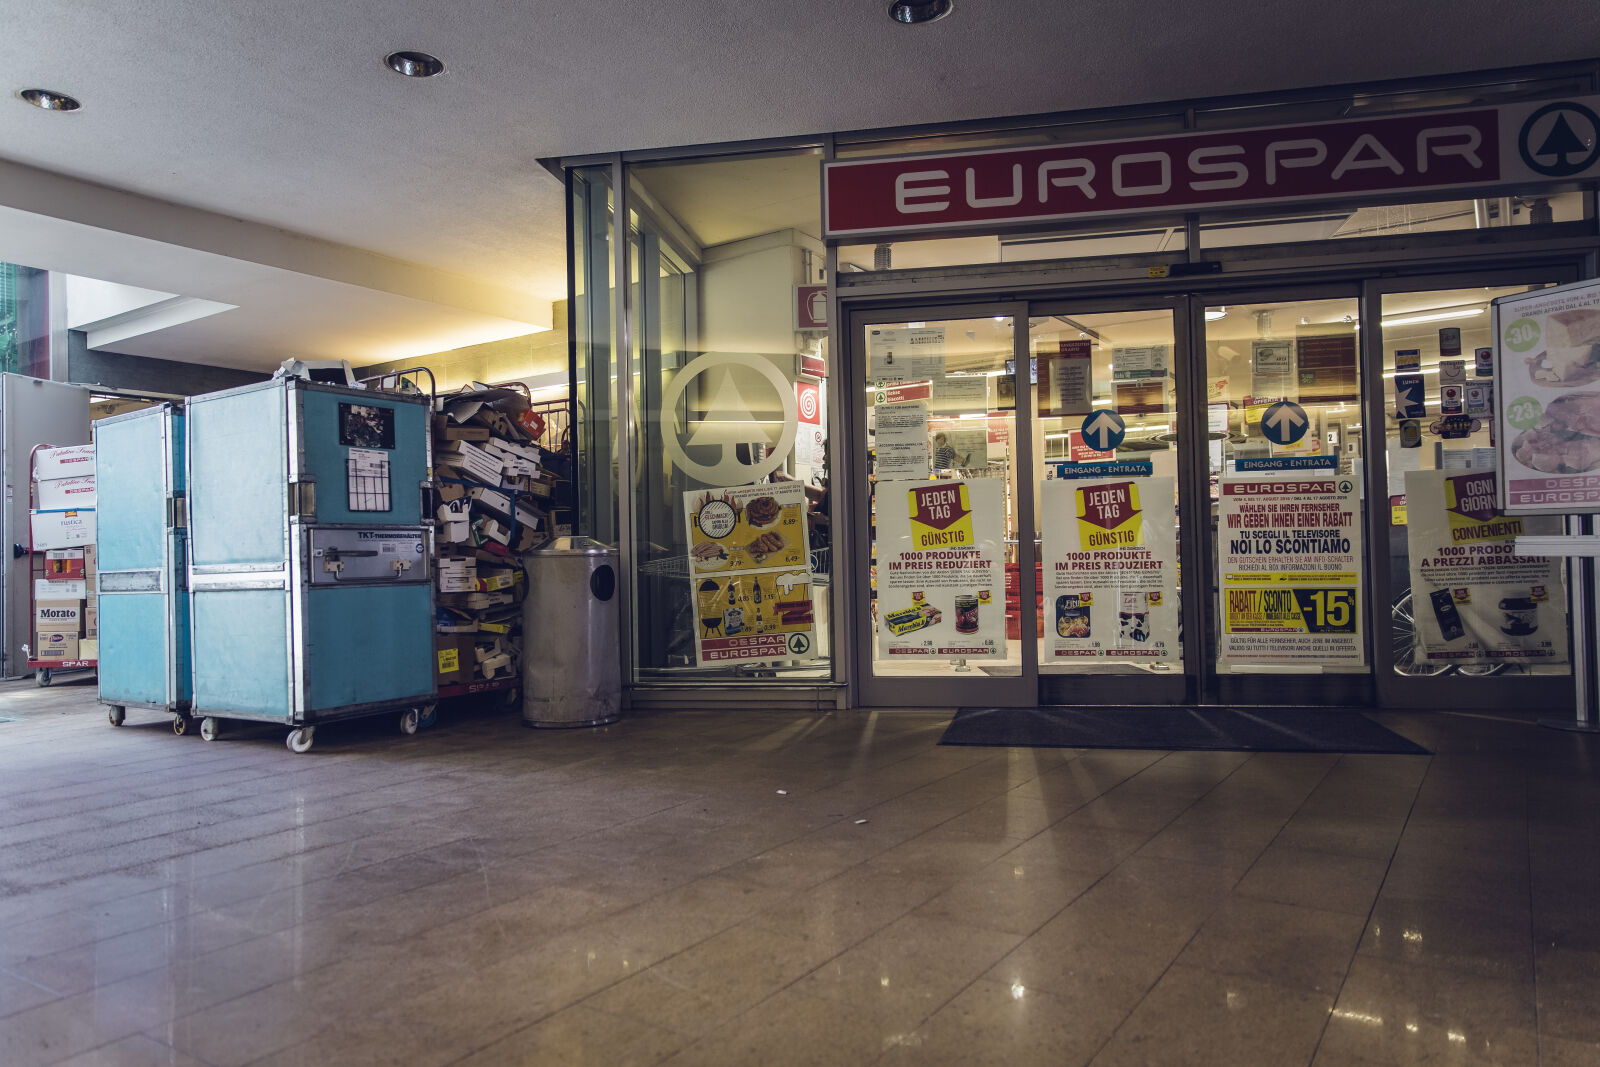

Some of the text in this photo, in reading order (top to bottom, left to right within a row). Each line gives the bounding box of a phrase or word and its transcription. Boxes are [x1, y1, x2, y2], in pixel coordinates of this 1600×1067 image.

[894, 124, 1483, 214] EUROSPAR
[1109, 465, 1146, 473] ENTRATA
[1291, 459, 1331, 467] ENTRATA
[1234, 483, 1335, 493] EUROSPAR
[1466, 479, 1494, 496] OGNI
[1545, 477, 1600, 488] DESP
[921, 489, 956, 507] JEDEN
[1089, 489, 1125, 507] JEDEN
[1461, 494, 1496, 512] GIORN
[1520, 491, 1600, 503] EUROSP
[929, 505, 951, 520] TAG
[1096, 504, 1120, 520] TAG
[1240, 503, 1340, 513] WÄHLEN SIE IHREN FERNSEHER
[1227, 512, 1353, 528] WIR GEBEN IHNEN EINEN RABATT
[1240, 529, 1340, 539] TU SCEGLI IL TELEVISORE
[1452, 520, 1522, 541] CONVENIENTI
[921, 530, 965, 547] GÜNSTIG
[1089, 530, 1135, 547] GÜNSTIG
[1230, 538, 1351, 554] NOI LO SCONTIAMO
[1438, 545, 1515, 556] 1000 PRODO
[900, 551, 981, 560] 1000 PRODUKTE
[1094, 551, 1151, 560] PRODUKTE
[889, 560, 992, 570] IM PREIS REDUZIERT
[1056, 561, 1163, 570] IM PREIS REDUZIERT
[1421, 559, 1430, 567] A
[1433, 557, 1474, 566] PREZZI
[1229, 590, 1256, 613] RABATT
[1264, 590, 1292, 613] SCONTO
[40, 608, 76, 618] Morato
[729, 635, 786, 646] DESPAR
[710, 646, 787, 659] EUROSPAR
